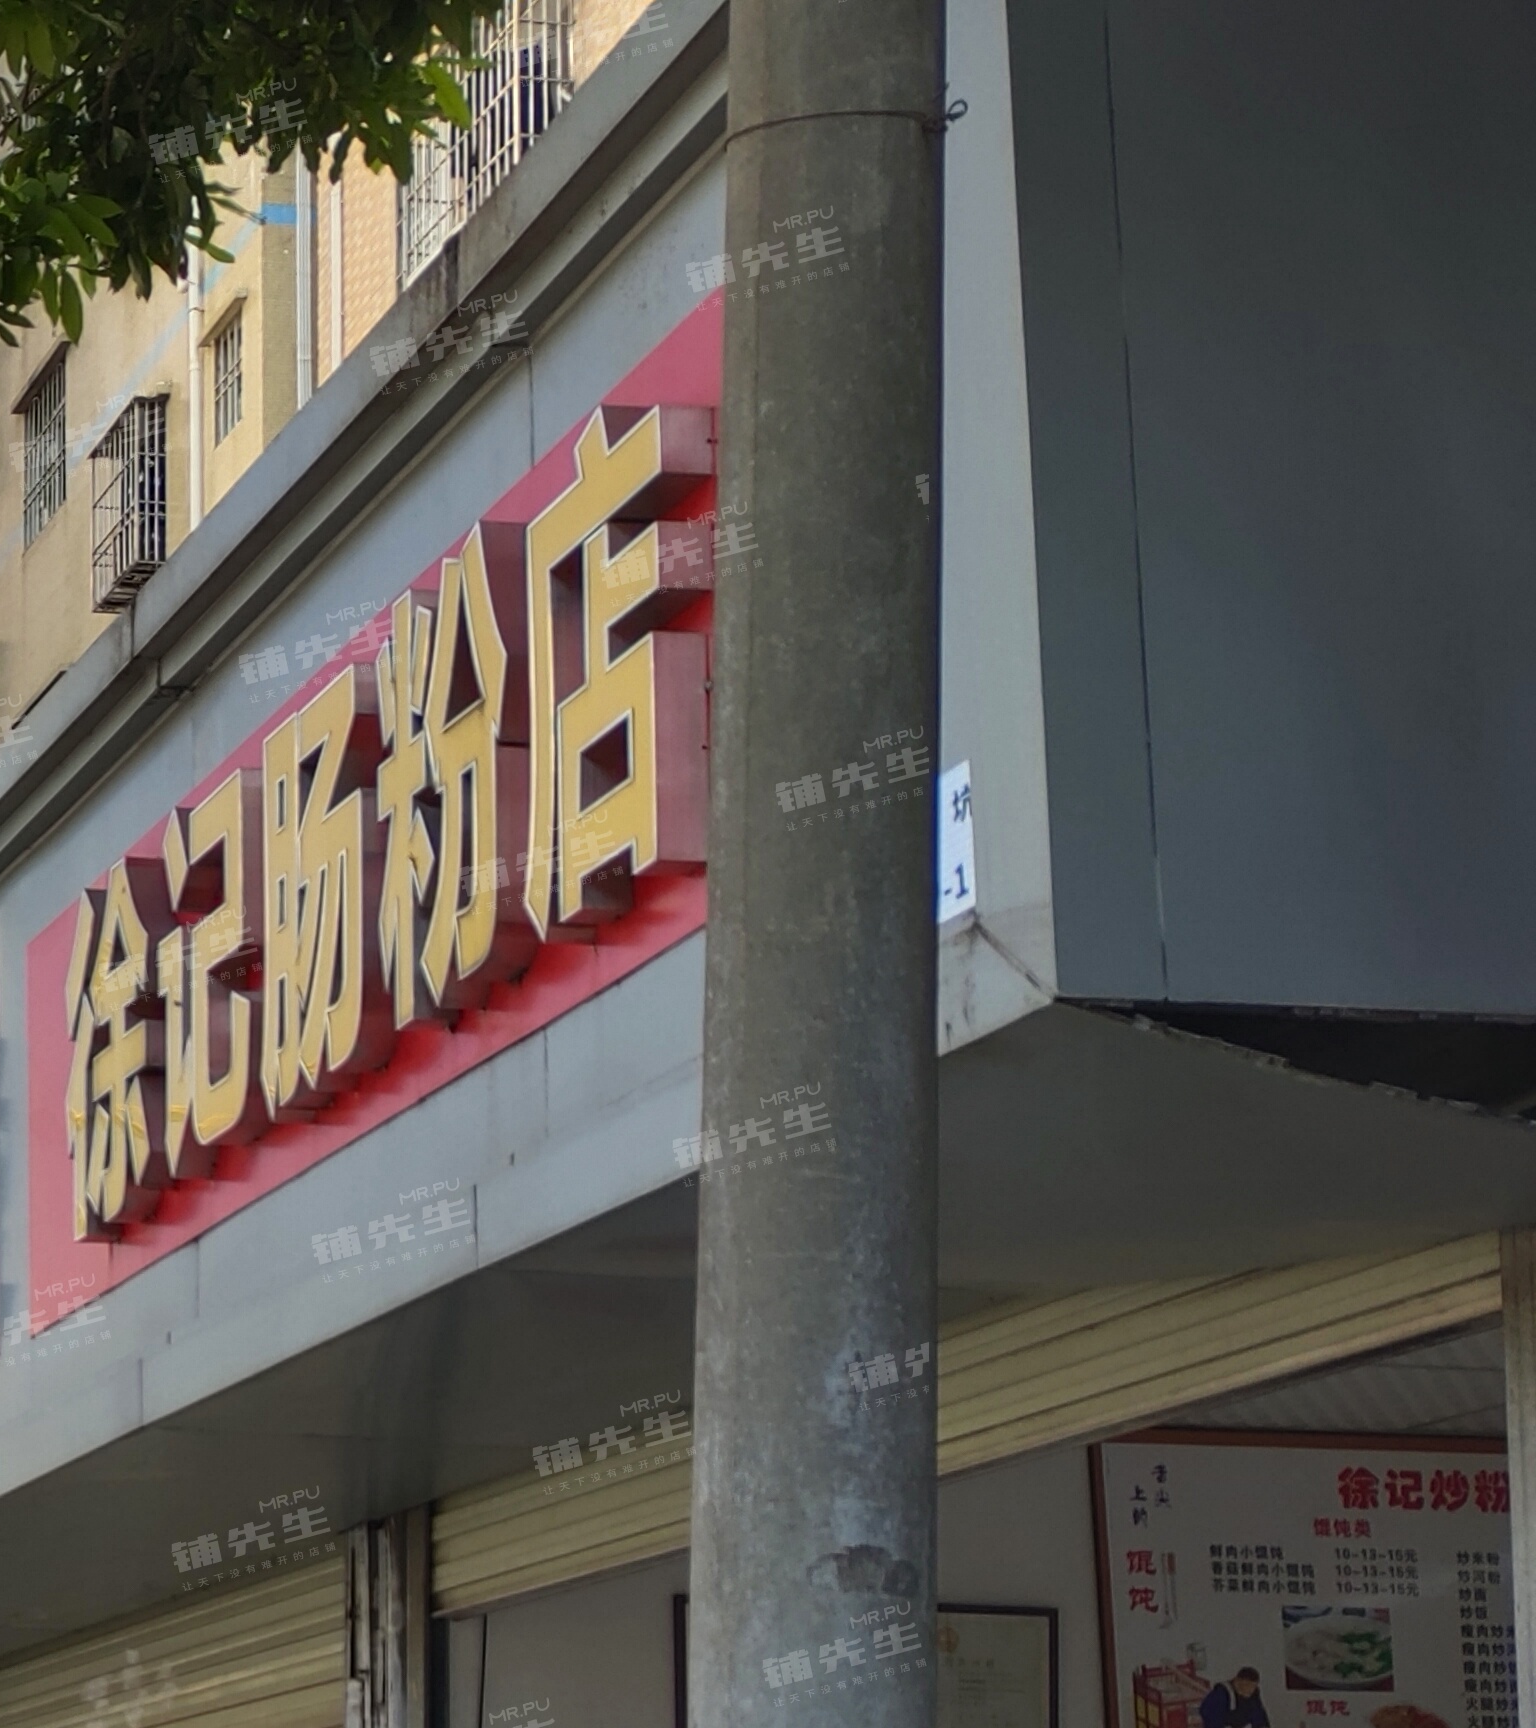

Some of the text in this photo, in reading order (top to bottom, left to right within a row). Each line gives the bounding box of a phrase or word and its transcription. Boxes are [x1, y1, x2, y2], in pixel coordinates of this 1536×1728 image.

[65, 405, 663, 1243] 徐记肠粉店
